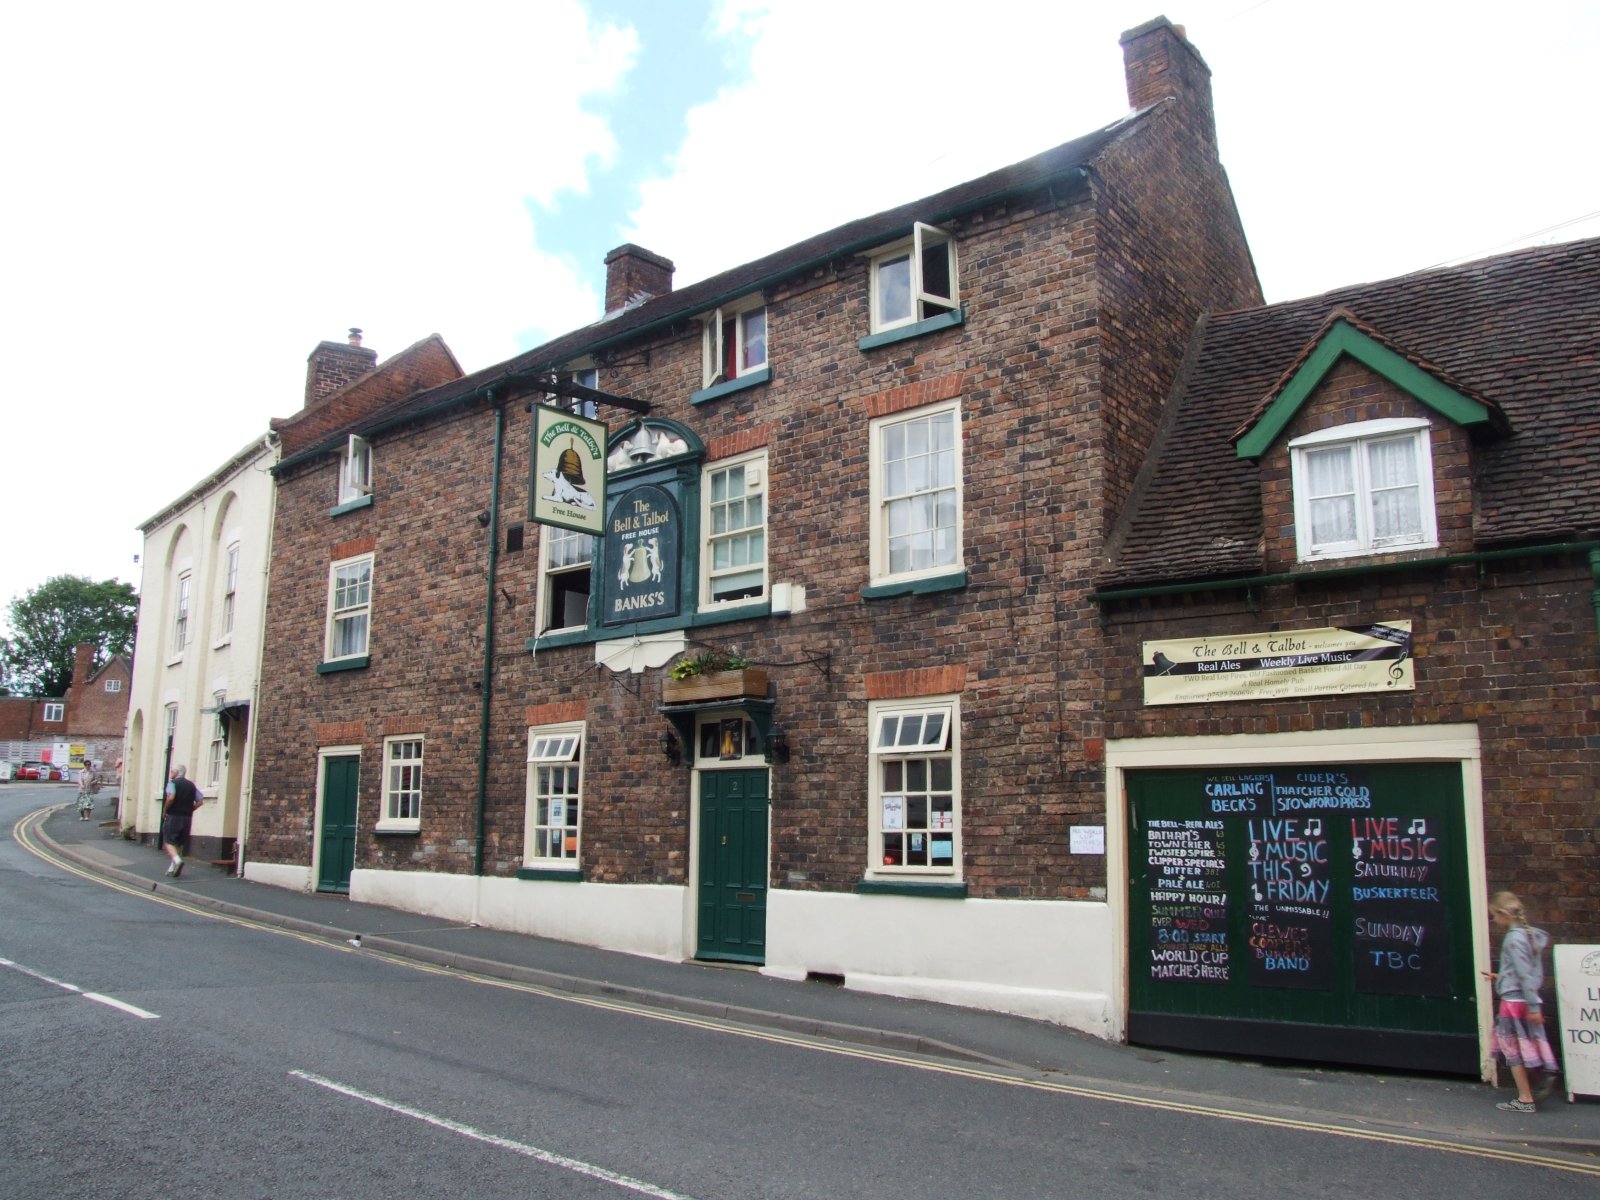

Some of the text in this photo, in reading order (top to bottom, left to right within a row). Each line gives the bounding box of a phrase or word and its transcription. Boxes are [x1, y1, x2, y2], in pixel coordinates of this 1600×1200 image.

[543, 423, 600, 457] The Bell & Talbot
[552, 507, 587, 521] Free House
[633, 500, 650, 514] The
[614, 510, 669, 533] Bell & Talbot
[621, 527, 660, 541] FREE HOUSE
[614, 591, 665, 613] BANKS'S
[1193, 645, 1217, 658] The
[1222, 641, 1247, 656] Bell
[1252, 644, 1262, 654] &
[1266, 638, 1307, 653] Talbot
[1198, 652, 1352, 672] Real Ales Weekly Live Music
[1201, 674, 1216, 682] Real
[1298, 667, 1322, 675] Basket
[1248, 679, 1263, 688] Real
[1264, 677, 1290, 687] Homely
[1205, 782, 1264, 797] CARLING
[1275, 786, 1370, 798] THATCHER GOLD
[1211, 796, 1257, 813] BECK'S
[1339, 796, 1371, 809] PRESS
[1185, 821, 1204, 829] REAL
[1205, 821, 1224, 829] ALES
[1248, 819, 1301, 843] LIVE
[1351, 817, 1399, 841] LIVE
[1148, 840, 1180, 848] TOWN
[1181, 840, 1211, 849] CRIER
[1266, 841, 1328, 863] MUSIC
[1369, 838, 1437, 862] MUSIC
[1148, 849, 1187, 857] TWISTED
[1148, 857, 1184, 866] CLIPPER
[1163, 866, 1201, 875] BITTER
[1248, 860, 1293, 883] THIS
[1157, 879, 1183, 889] PALE
[1185, 880, 1205, 889] ALE
[1267, 879, 1330, 904] FRIDAY
[1150, 892, 1226, 905] HAPPY HOUR!
[1353, 886, 1439, 902] BUSKERTEER
[1254, 904, 1269, 912] THE
[1275, 905, 1321, 916] UNMISSABLE
[1174, 918, 1209, 931] WED
[1355, 917, 1425, 946] SUNDAY
[1151, 949, 1229, 964] WORLD CUP
[1265, 957, 1310, 971] BAND
[1369, 950, 1421, 970] TBC
[1151, 964, 1200, 978] MATCHES
